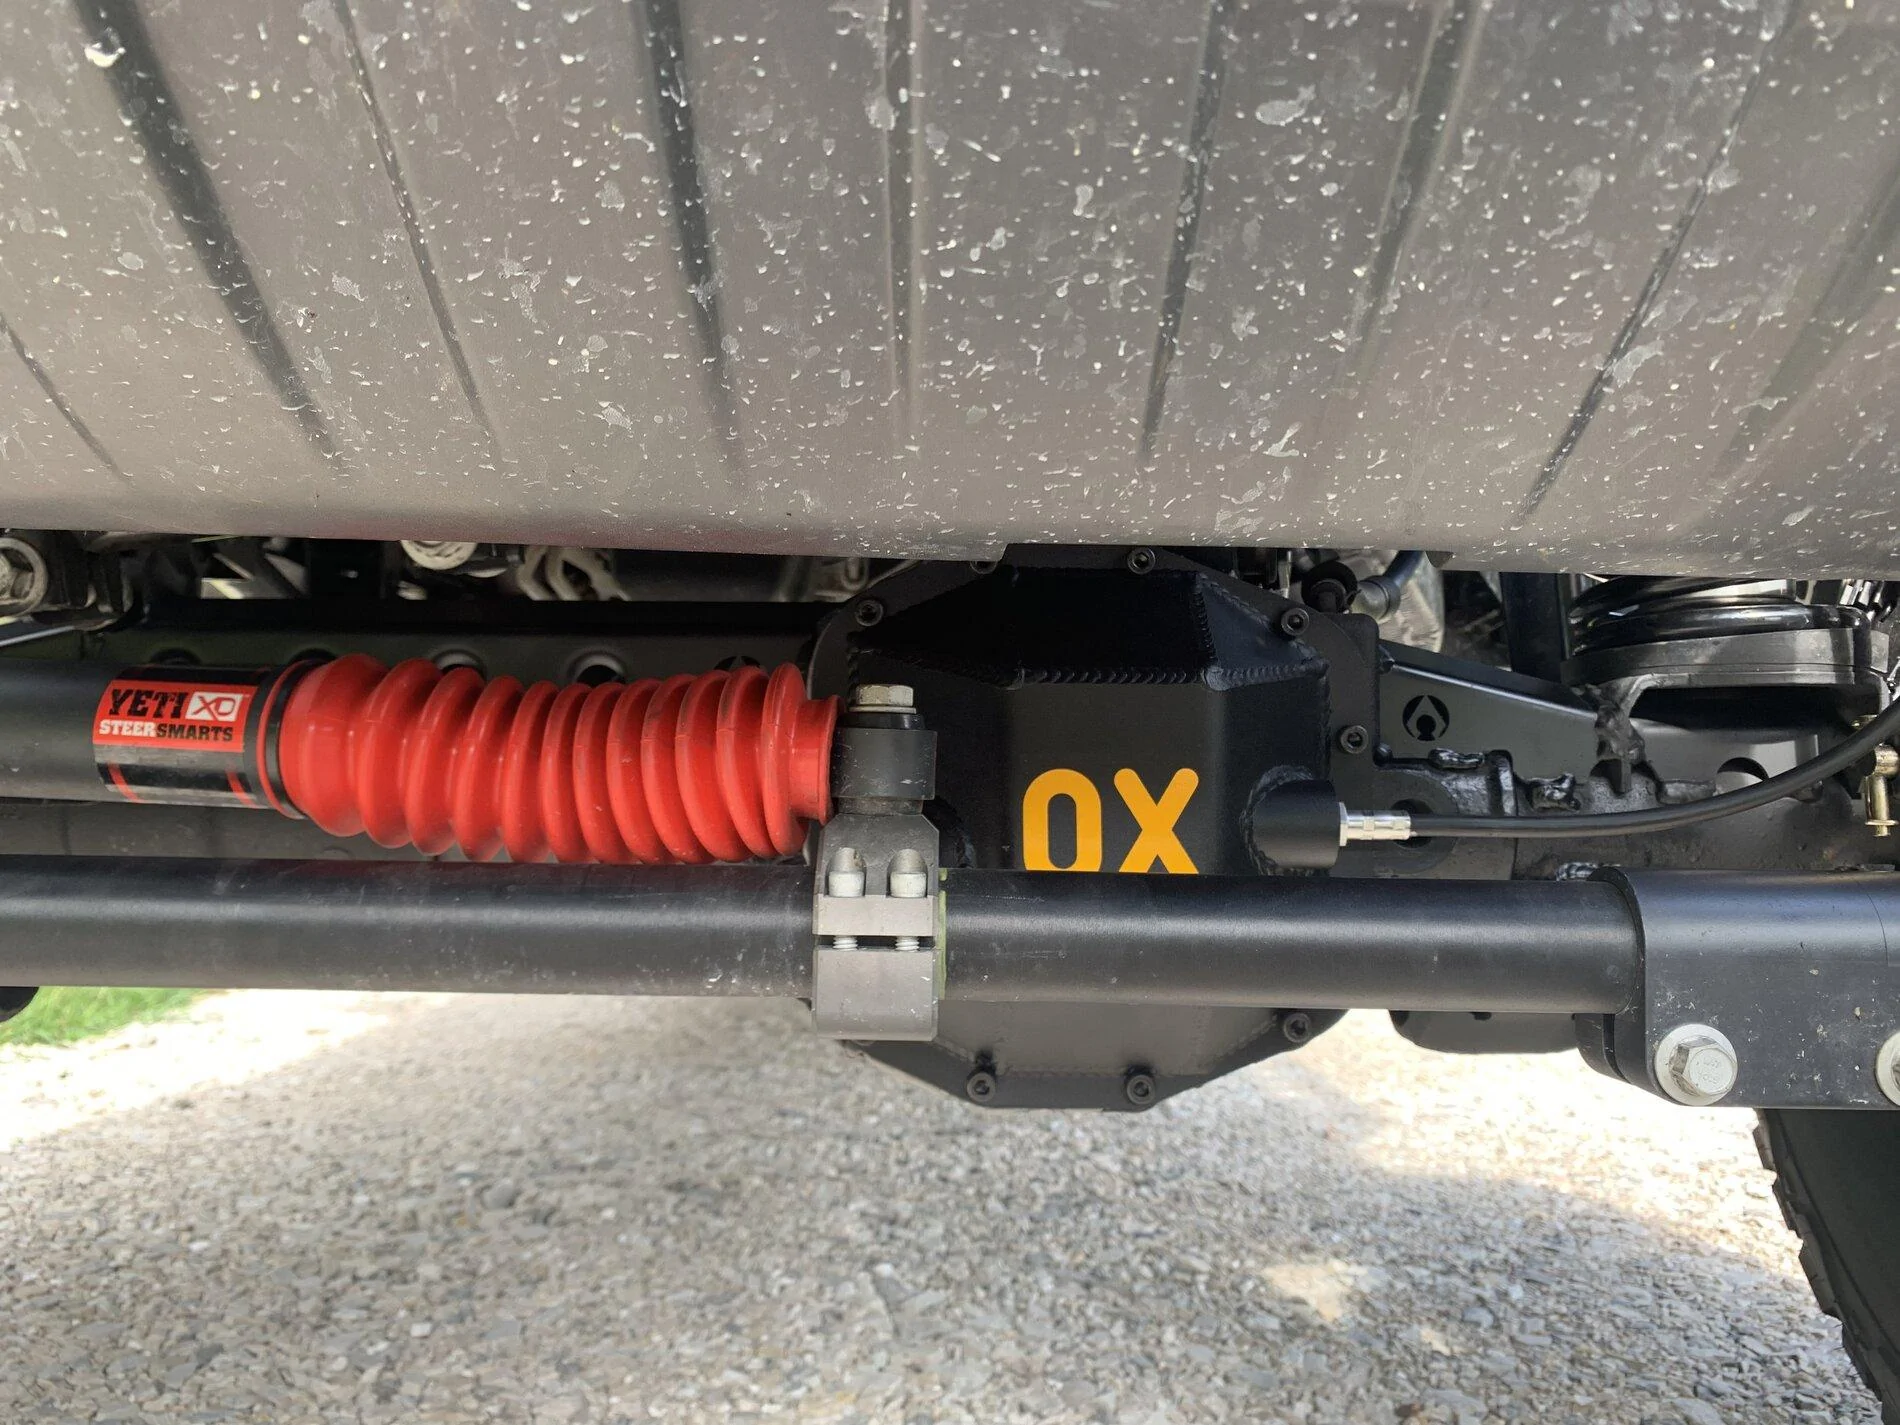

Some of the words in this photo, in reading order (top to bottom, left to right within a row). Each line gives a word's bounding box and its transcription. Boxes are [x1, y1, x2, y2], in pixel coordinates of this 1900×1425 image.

[109, 688, 188, 719] YETI
[99, 719, 233, 741] STEERSMARTS
[1023, 767, 1199, 874] OX
